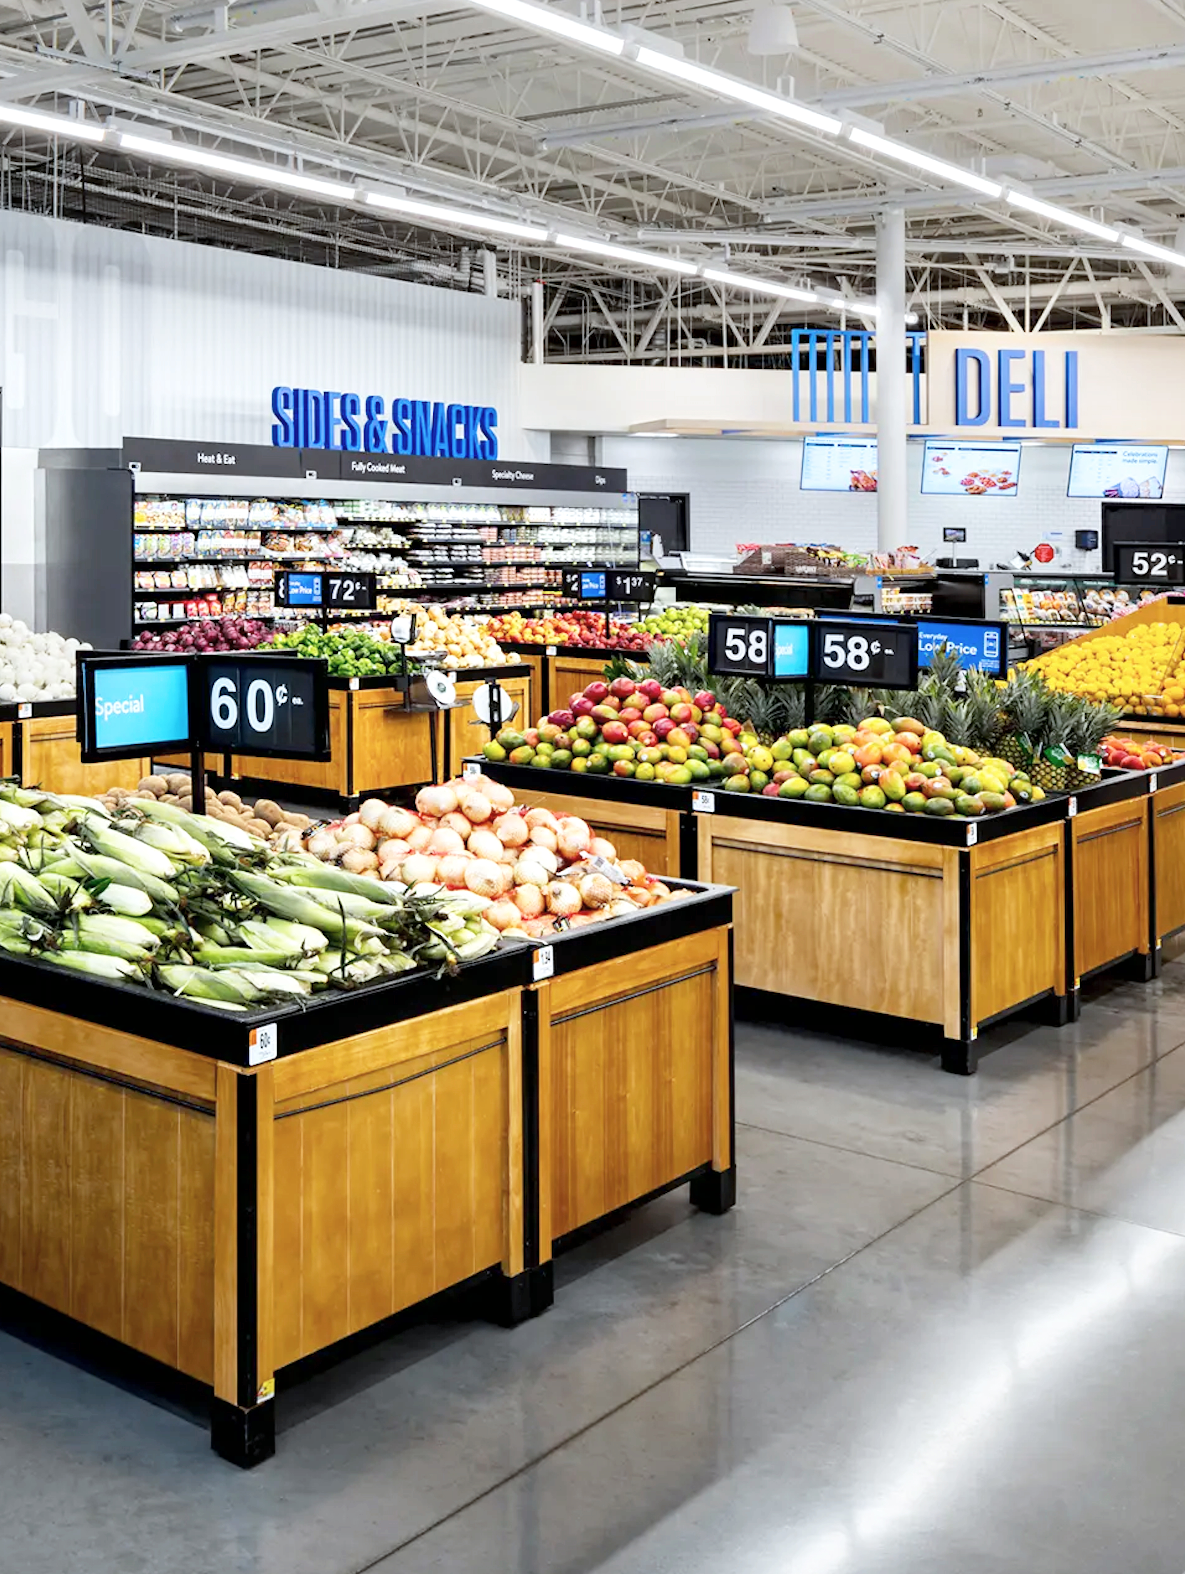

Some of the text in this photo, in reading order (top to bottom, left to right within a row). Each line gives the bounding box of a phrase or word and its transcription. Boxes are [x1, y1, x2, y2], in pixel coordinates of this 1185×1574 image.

[955, 348, 1078, 429] DELI
[271, 386, 499, 461] SIDES & SNACKS
[197, 452, 236, 465] Heat & Eat
[351, 461, 406, 474] Fully Cooked Meat
[491, 468, 534, 482] Specialty Cheese
[918, 631, 949, 642] Everyday
[946, 641, 978, 656] Price
[95, 693, 145, 721] Special
